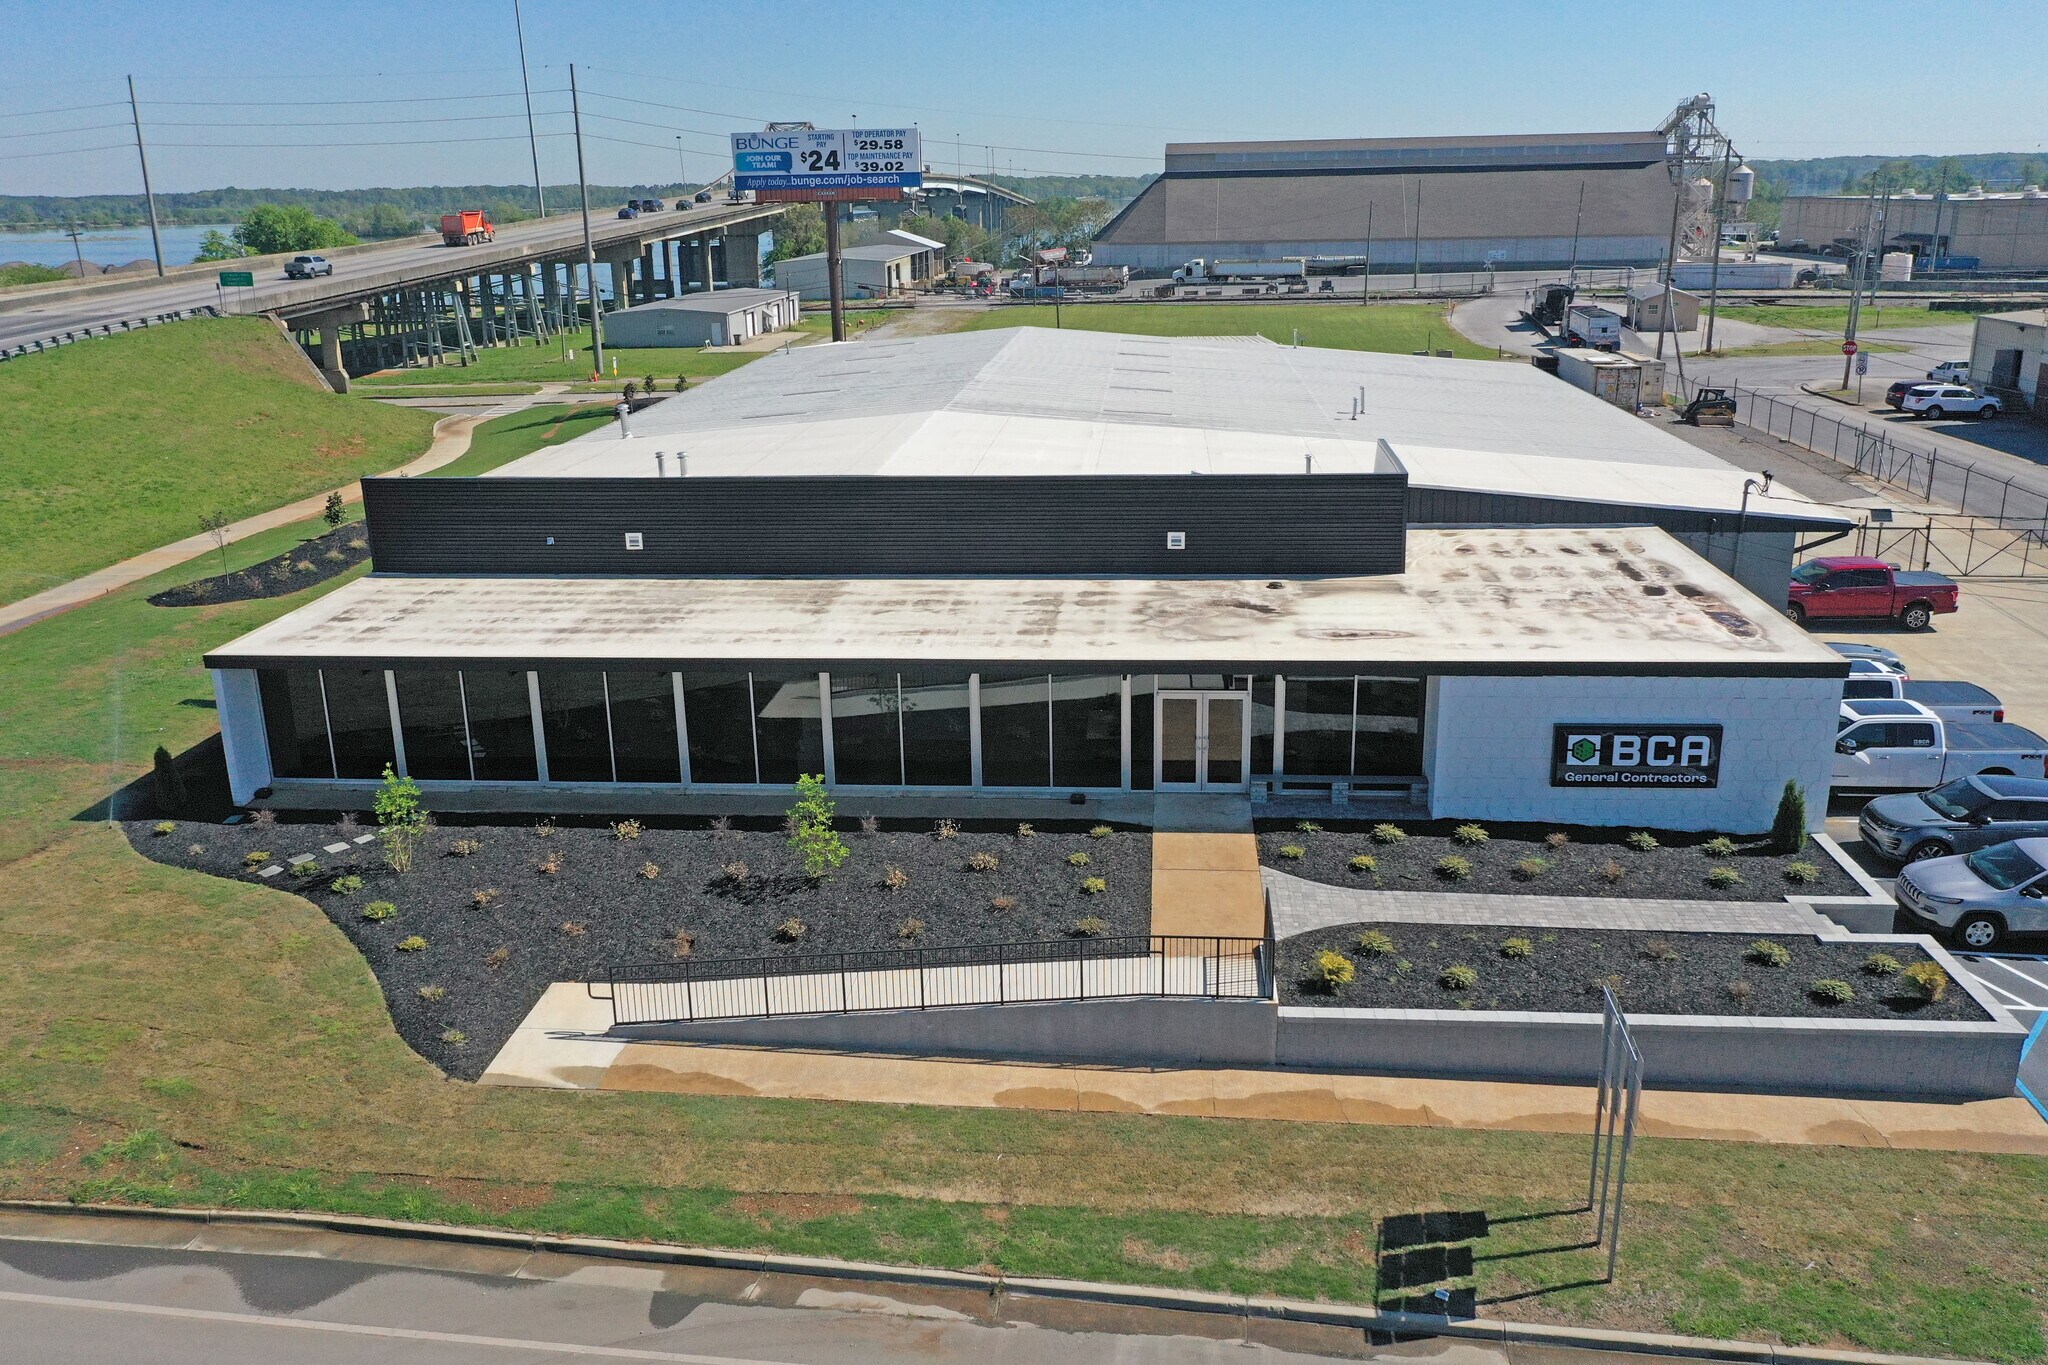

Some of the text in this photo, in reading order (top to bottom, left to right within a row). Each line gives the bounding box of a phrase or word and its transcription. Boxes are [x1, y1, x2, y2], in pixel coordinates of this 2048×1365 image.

[807, 133, 835, 141] STARTING
[852, 131, 864, 139] TOP
[864, 130, 895, 138] OPERATOR
[736, 136, 799, 150] BUNGE
[854, 139, 904, 150] $29.58
[764, 154, 782, 162] OUR
[800, 150, 840, 172] $24
[859, 152, 901, 160] MAINTENANCE
[752, 161, 777, 169] TEAM!
[854, 161, 905, 172] $39.02
[747, 178, 767, 187] Apply
[1611, 735, 1711, 767] BCA
[1565, 772, 1708, 784] General Contractors
